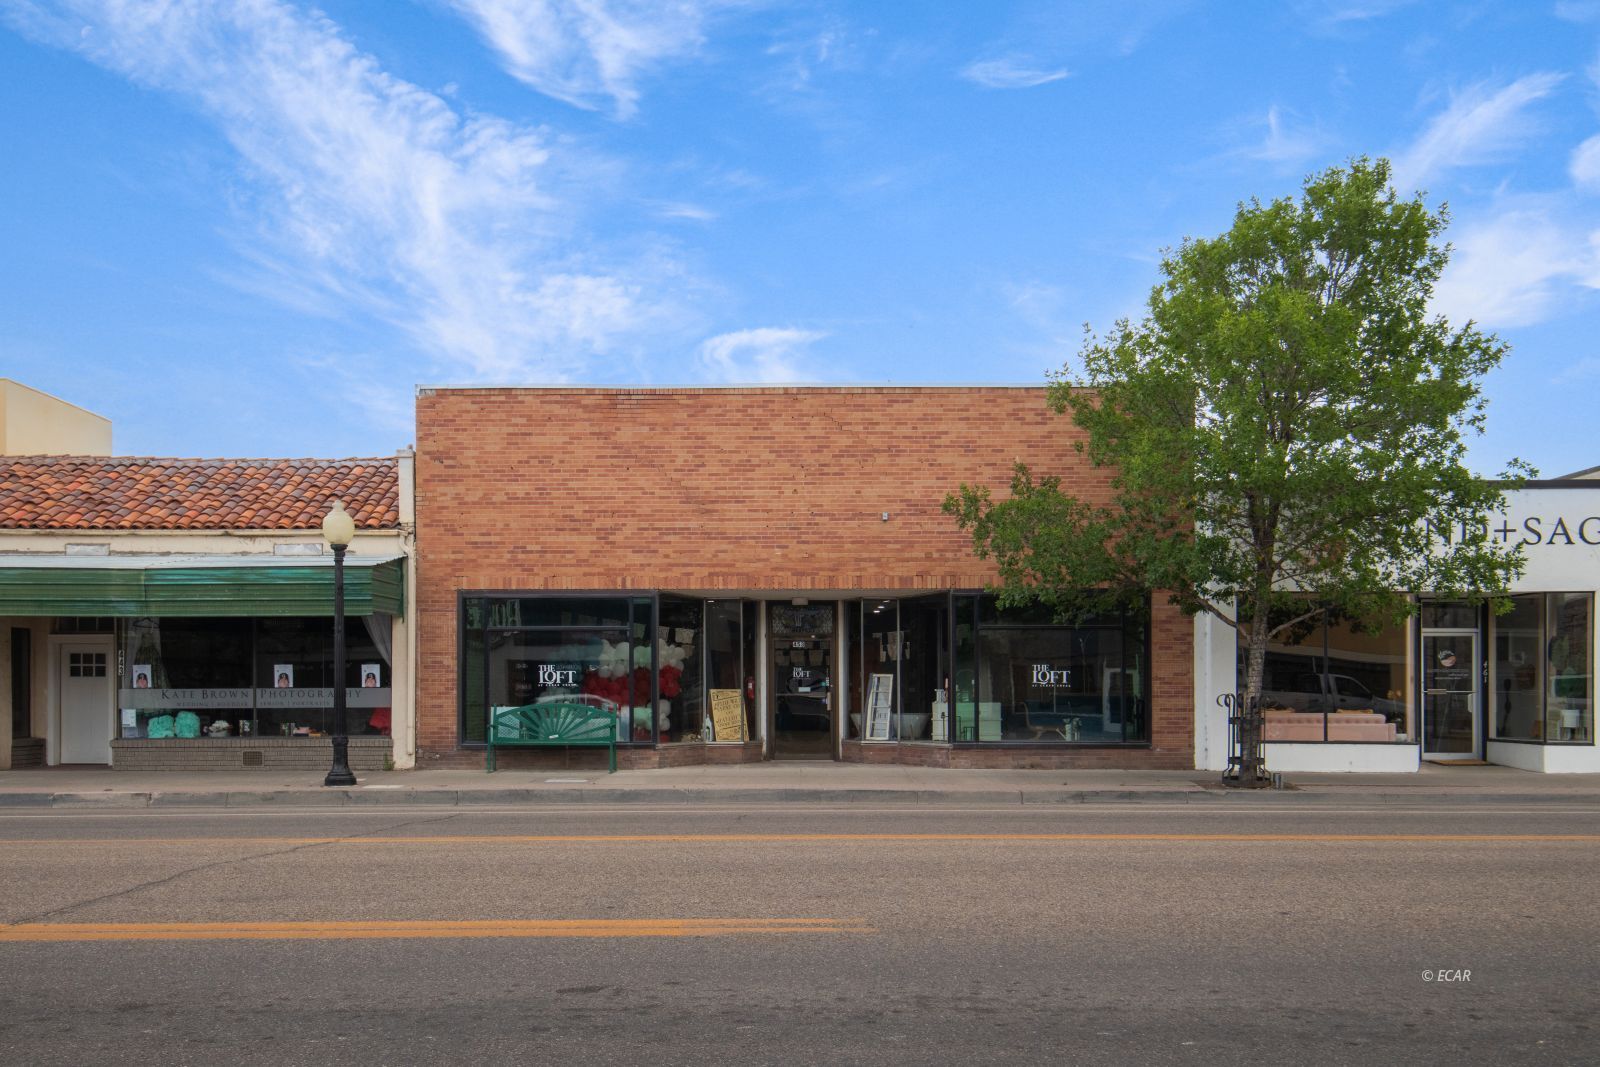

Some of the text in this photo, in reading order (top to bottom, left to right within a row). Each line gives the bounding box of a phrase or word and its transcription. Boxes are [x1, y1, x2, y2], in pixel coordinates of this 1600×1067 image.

[538, 670, 577, 684] LOFT
[1032, 670, 1071, 684] LOFT
[260, 689, 361, 699] PHOTOGRAHY
